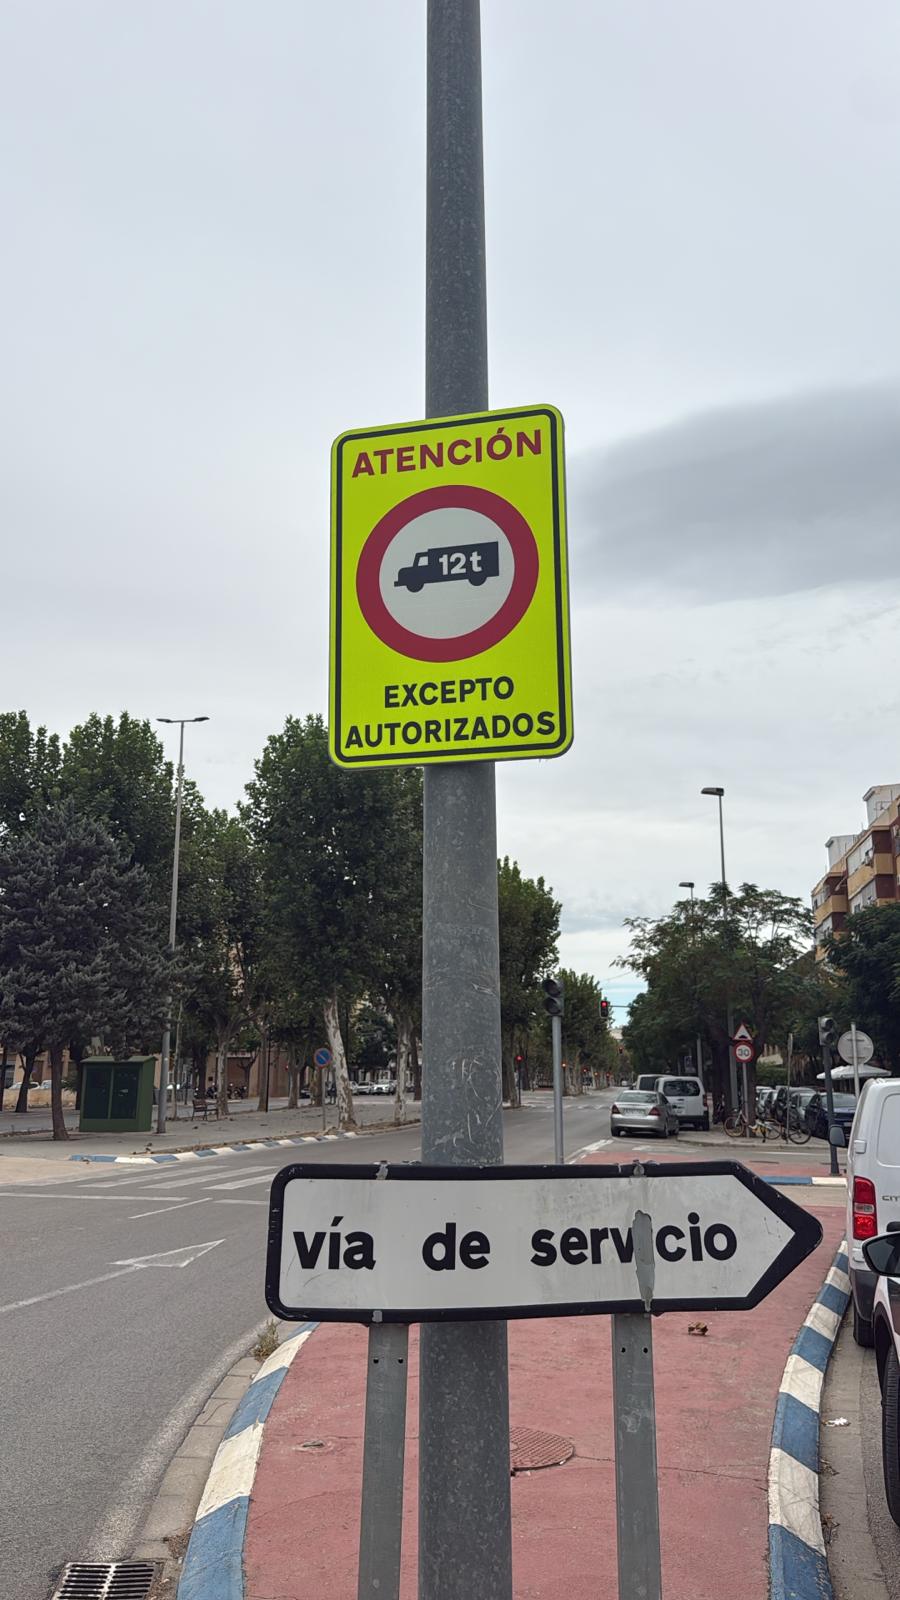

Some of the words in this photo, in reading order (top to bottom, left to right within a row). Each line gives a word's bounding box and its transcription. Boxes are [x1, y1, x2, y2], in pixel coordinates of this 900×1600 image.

[351, 427, 542, 478] ATENCIÓN
[384, 676, 515, 708] EXCEPTO
[344, 711, 556, 749] AUTORIZADOS
[738, 1048, 750, 1057] 30
[293, 1215, 376, 1270] vía
[422, 1222, 491, 1271] de
[530, 1211, 737, 1267] servcio
